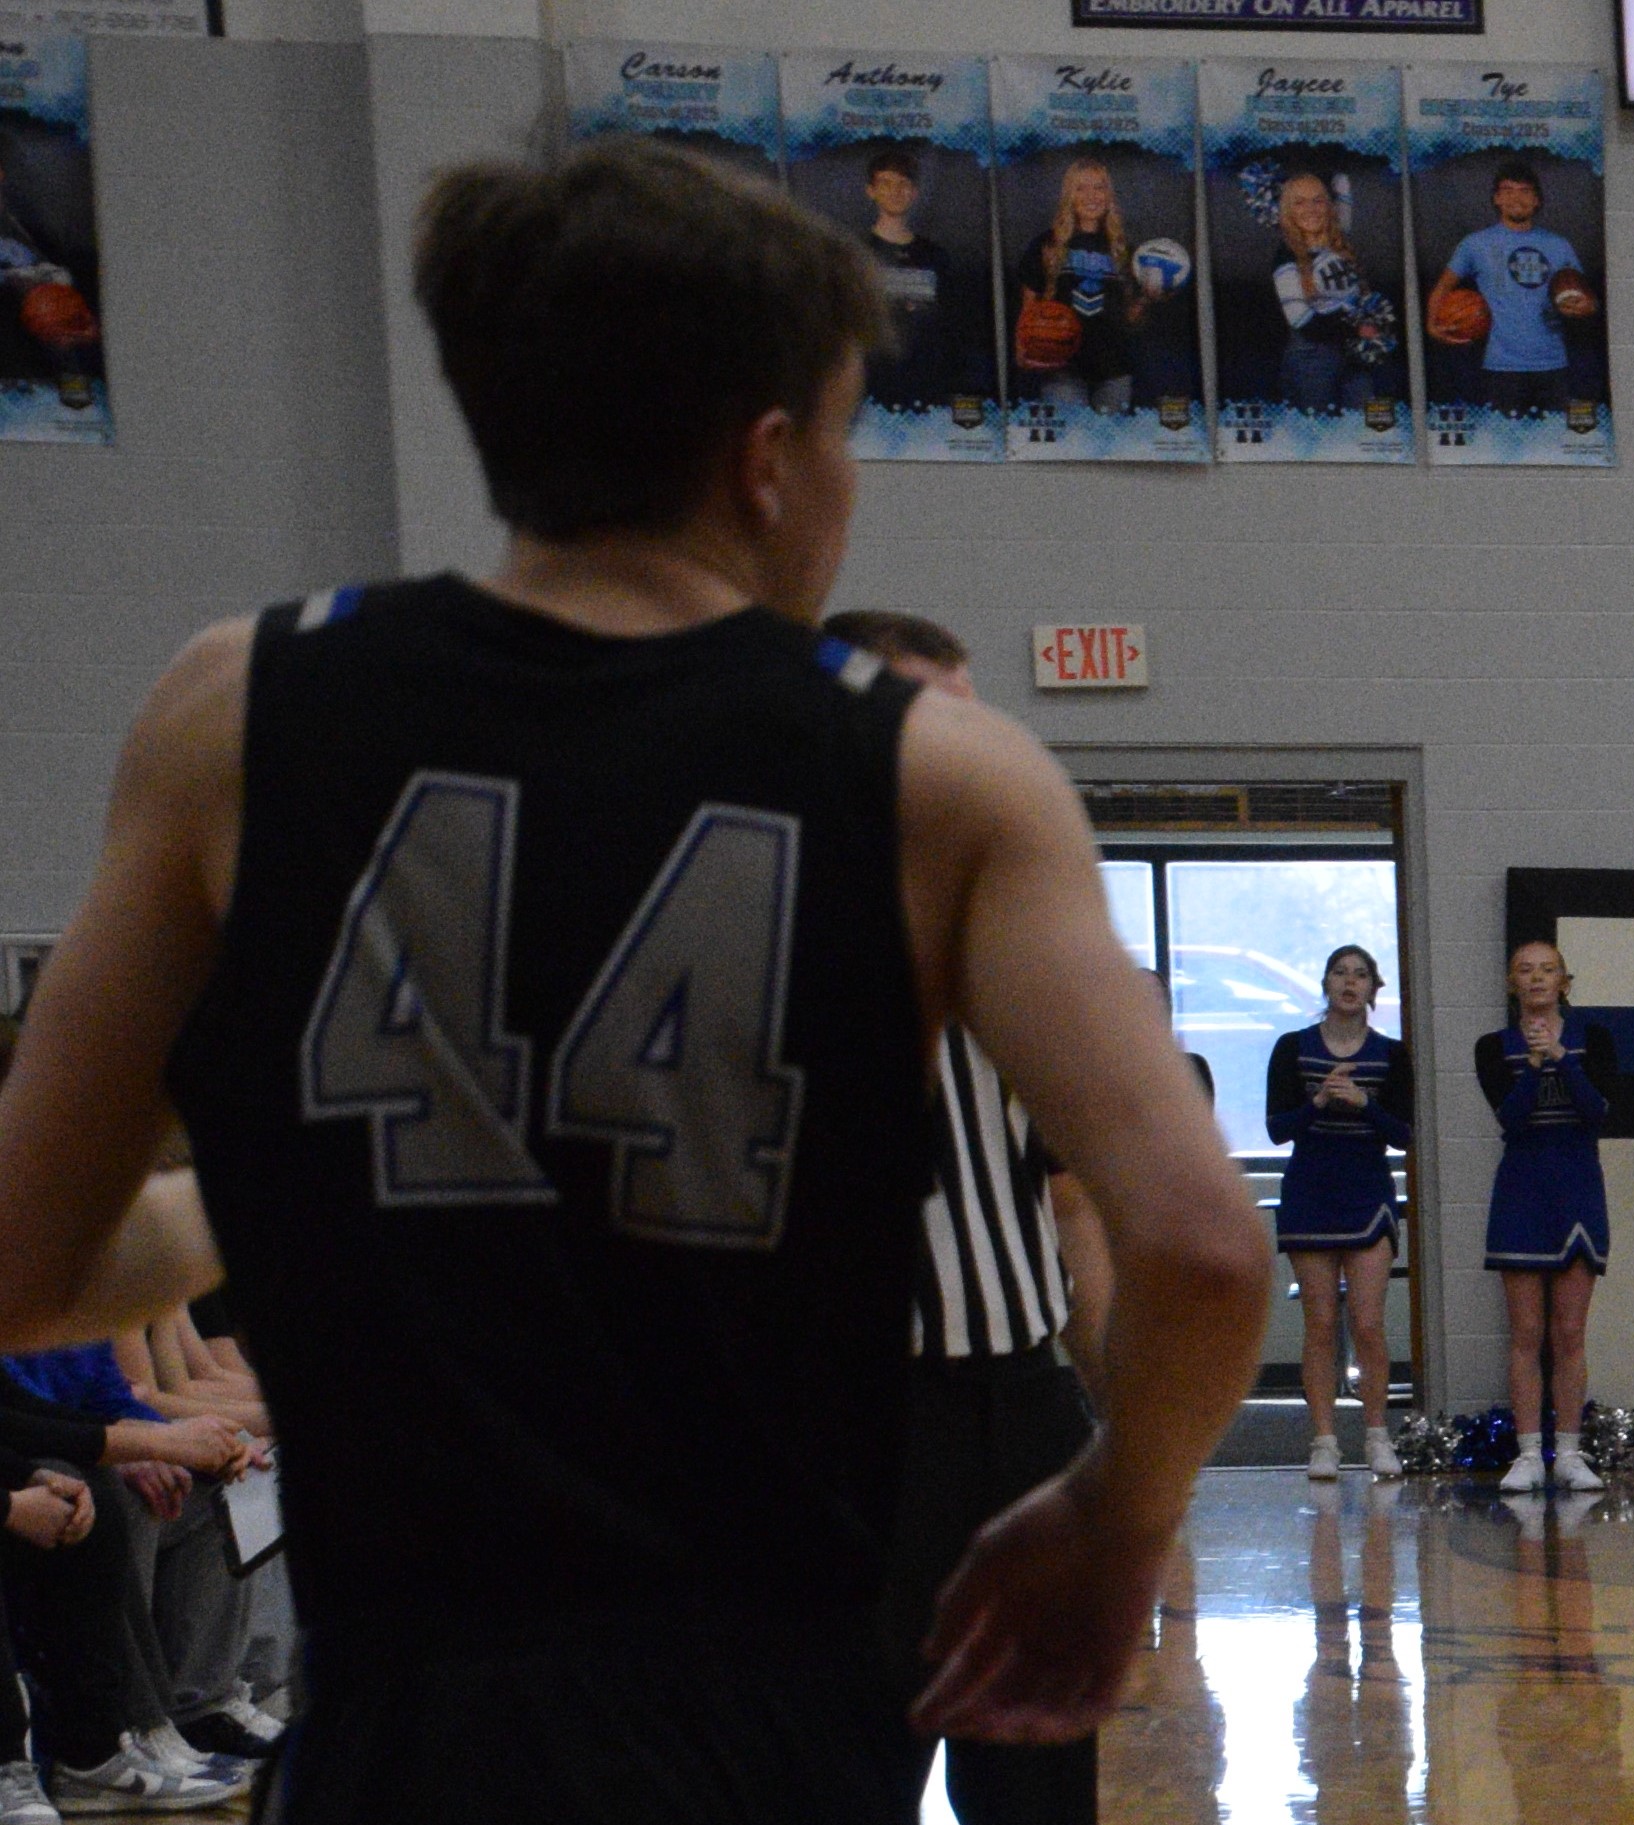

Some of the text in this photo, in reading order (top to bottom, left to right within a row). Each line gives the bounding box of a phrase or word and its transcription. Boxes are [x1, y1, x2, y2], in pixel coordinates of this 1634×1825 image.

[1089, 0, 1463, 18] EMBROIDERY ON ALL APPAREL
[620, 51, 722, 80] Carson
[824, 61, 944, 92] Anthony
[1055, 64, 1132, 94] Kylie
[1256, 67, 1344, 98] Jaycee
[1481, 73, 1528, 101] Tye
[1056, 628, 1128, 681] EXIT
[301, 771, 806, 1251] 44
